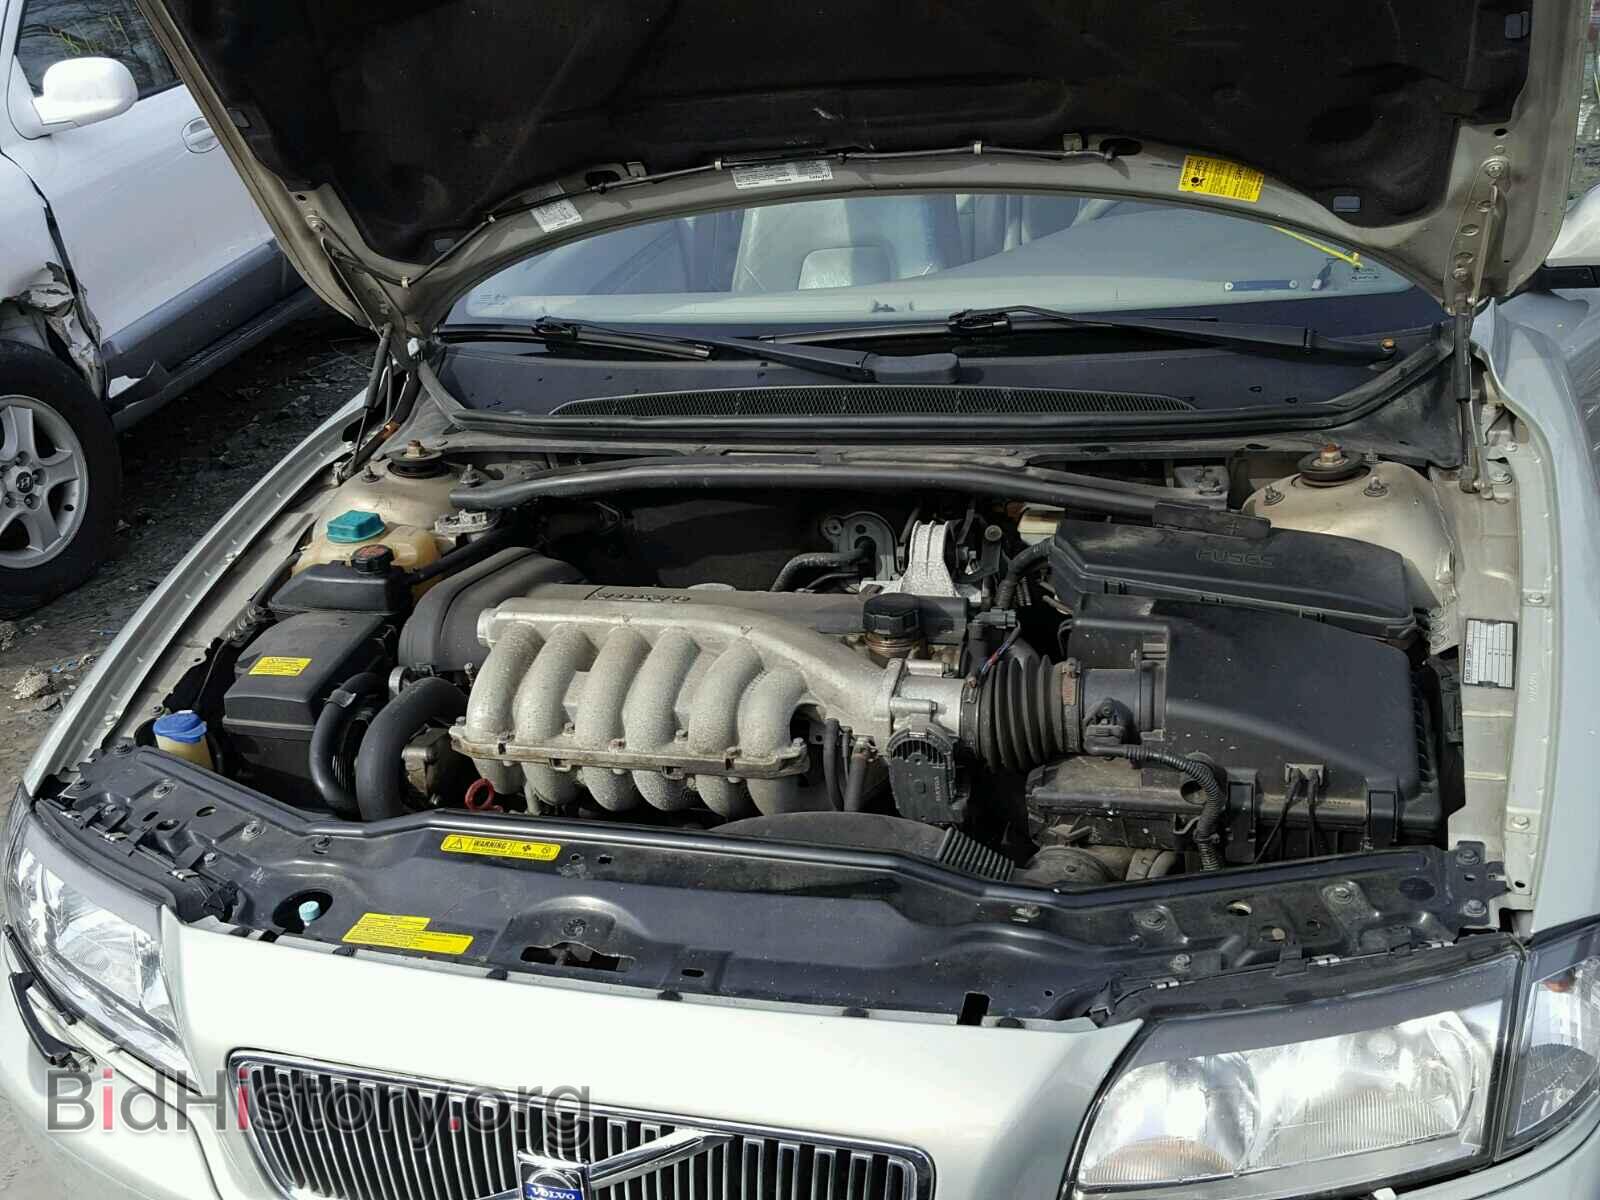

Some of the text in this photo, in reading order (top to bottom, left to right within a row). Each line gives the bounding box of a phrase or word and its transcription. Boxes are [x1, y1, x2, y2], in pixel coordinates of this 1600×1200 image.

[1195, 550, 1275, 569] FUSES
[473, 839, 506, 849] WARNING
[530, 1186, 576, 1200] VOLVO
